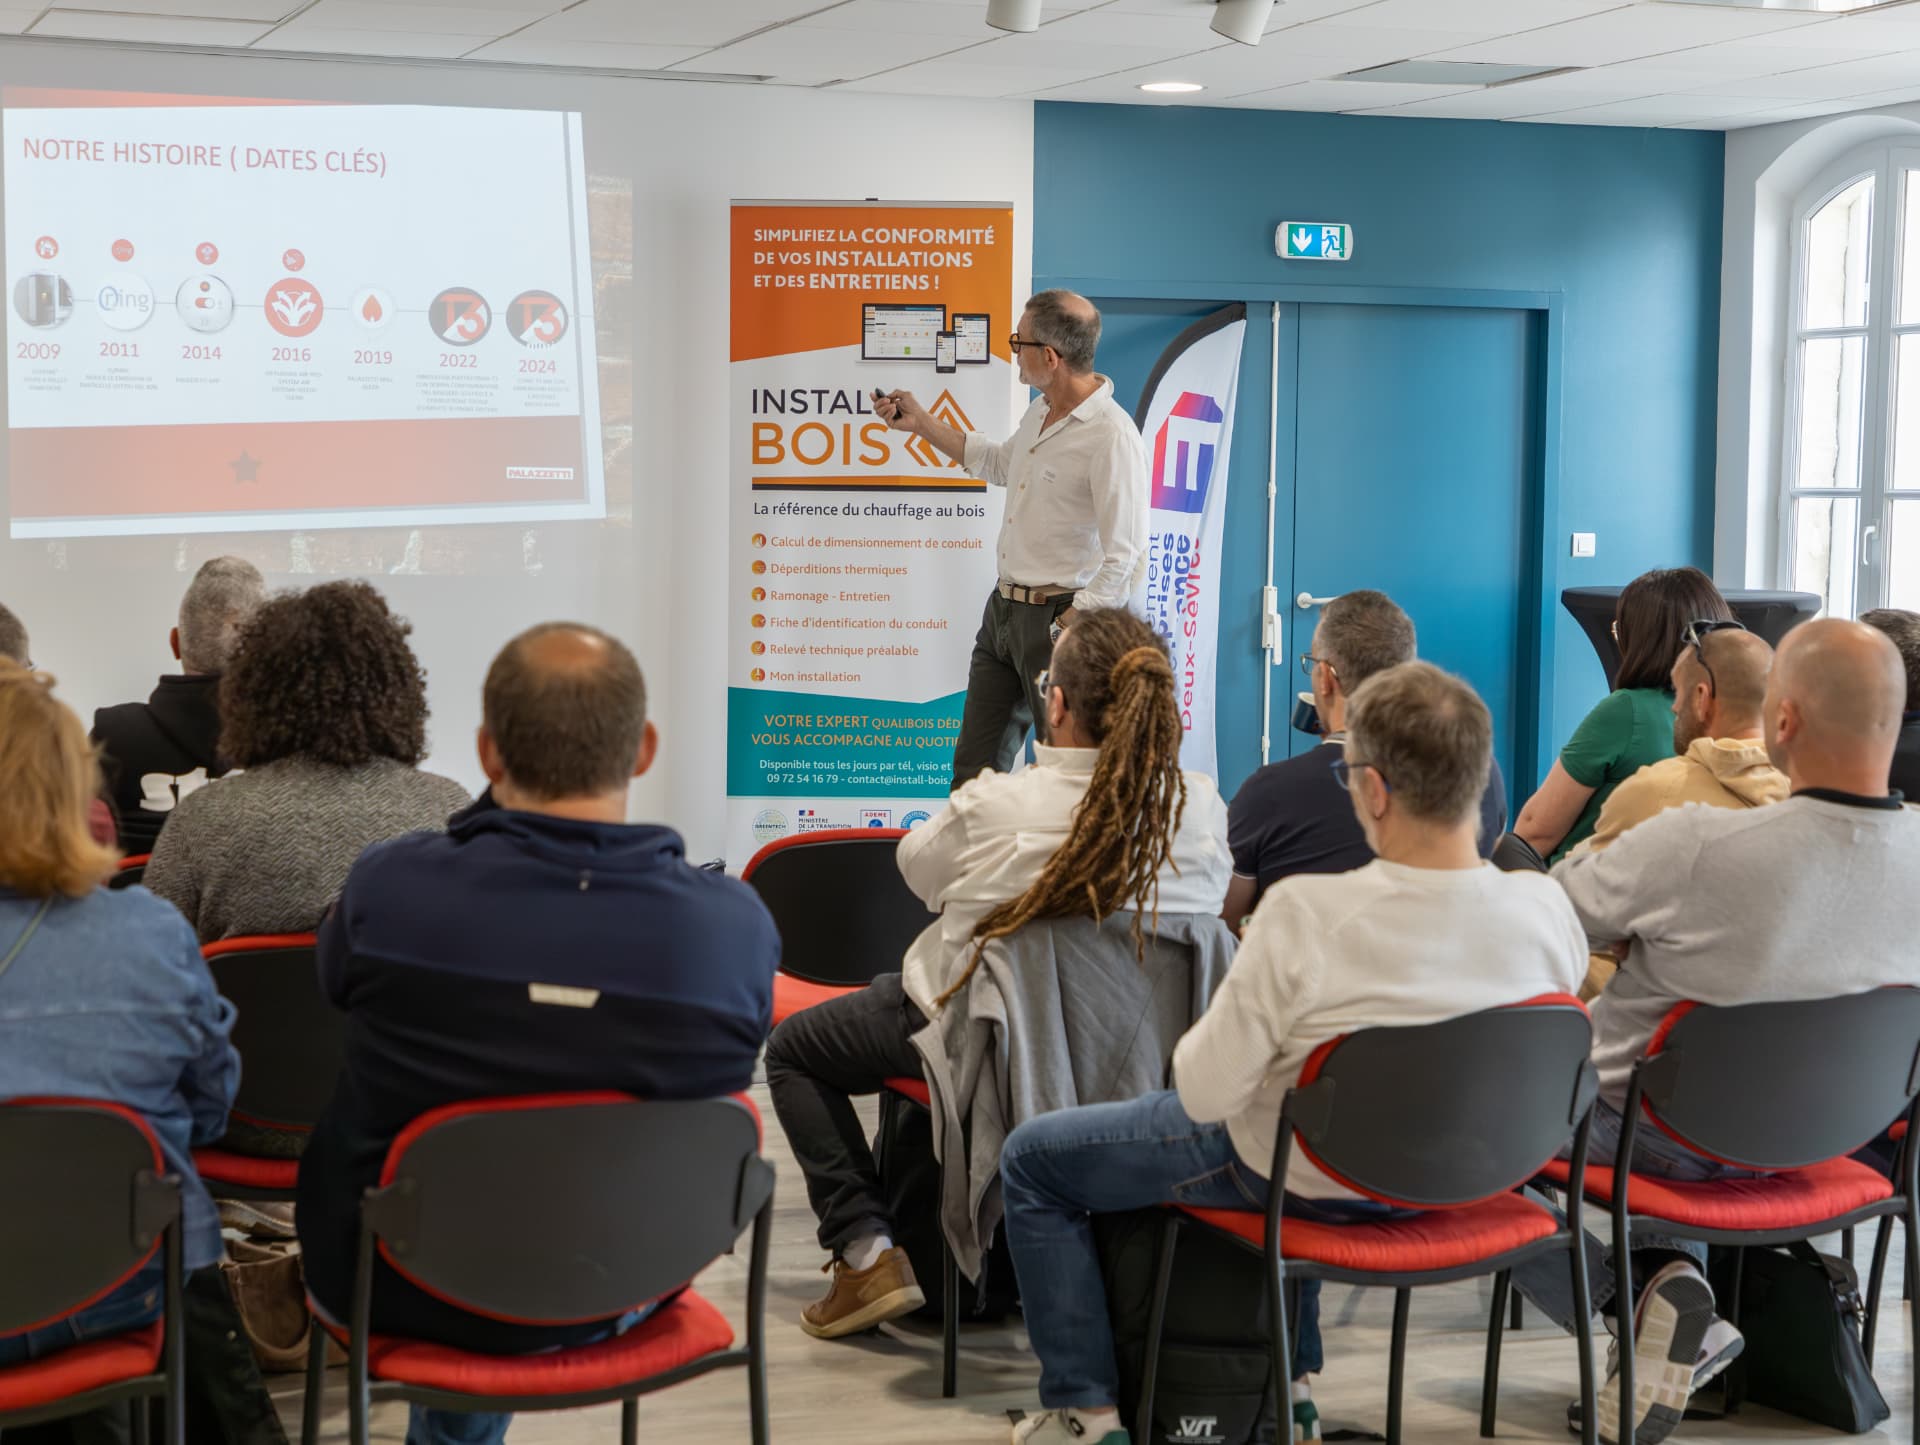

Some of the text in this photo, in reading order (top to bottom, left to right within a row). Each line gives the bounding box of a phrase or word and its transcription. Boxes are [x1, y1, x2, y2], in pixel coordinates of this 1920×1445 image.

[23, 138, 105, 162] NOTRE
[113, 142, 222, 167] HISTOIRE
[245, 147, 318, 171] DATES
[325, 148, 388, 178] CLÉS)
[753, 225, 995, 245] SIMPLIFIEZ LA CONFORMITÉ
[753, 250, 973, 268] DE VOS INSTALLATIONS
[753, 274, 772, 288] ET
[774, 274, 805, 289] DES
[809, 273, 930, 291] ENTRETIENS
[16, 342, 62, 360] 2009
[99, 342, 140, 357] 2011
[181, 344, 222, 360] 2014
[271, 346, 312, 362] 2016
[353, 350, 393, 365] 2019
[439, 353, 478, 368] 2022
[519, 359, 557, 374] 2024
[752, 388, 873, 415] INSTAL
[752, 421, 891, 466] BOIS
[753, 501, 985, 520] La référence du chauffage au bois
[770, 535, 983, 549] Calcul de dimensionnement de conduit
[770, 562, 908, 577] Déperditions thermiques
[770, 590, 829, 604] Ramonage
[839, 590, 891, 602] Entretien
[769, 616, 948, 630] Fiche d'identification du conduit
[769, 643, 920, 659] Relevé technique préalable
[769, 671, 861, 682] Mon installation
[764, 714, 961, 730] VOTRE EXPERT QUALIBOIS DÉD
[751, 733, 959, 749] VOUS ACCOMPAGNE AU QUOTI
[759, 759, 951, 773] Disponible tous les jours par tél, visio et
[766, 773, 780, 784] 09
[782, 773, 794, 784] 72
[796, 774, 810, 784] 54
[812, 774, 824, 784] 16
[825, 774, 839, 785] 79
[847, 774, 952, 786] contact@install-bois.
